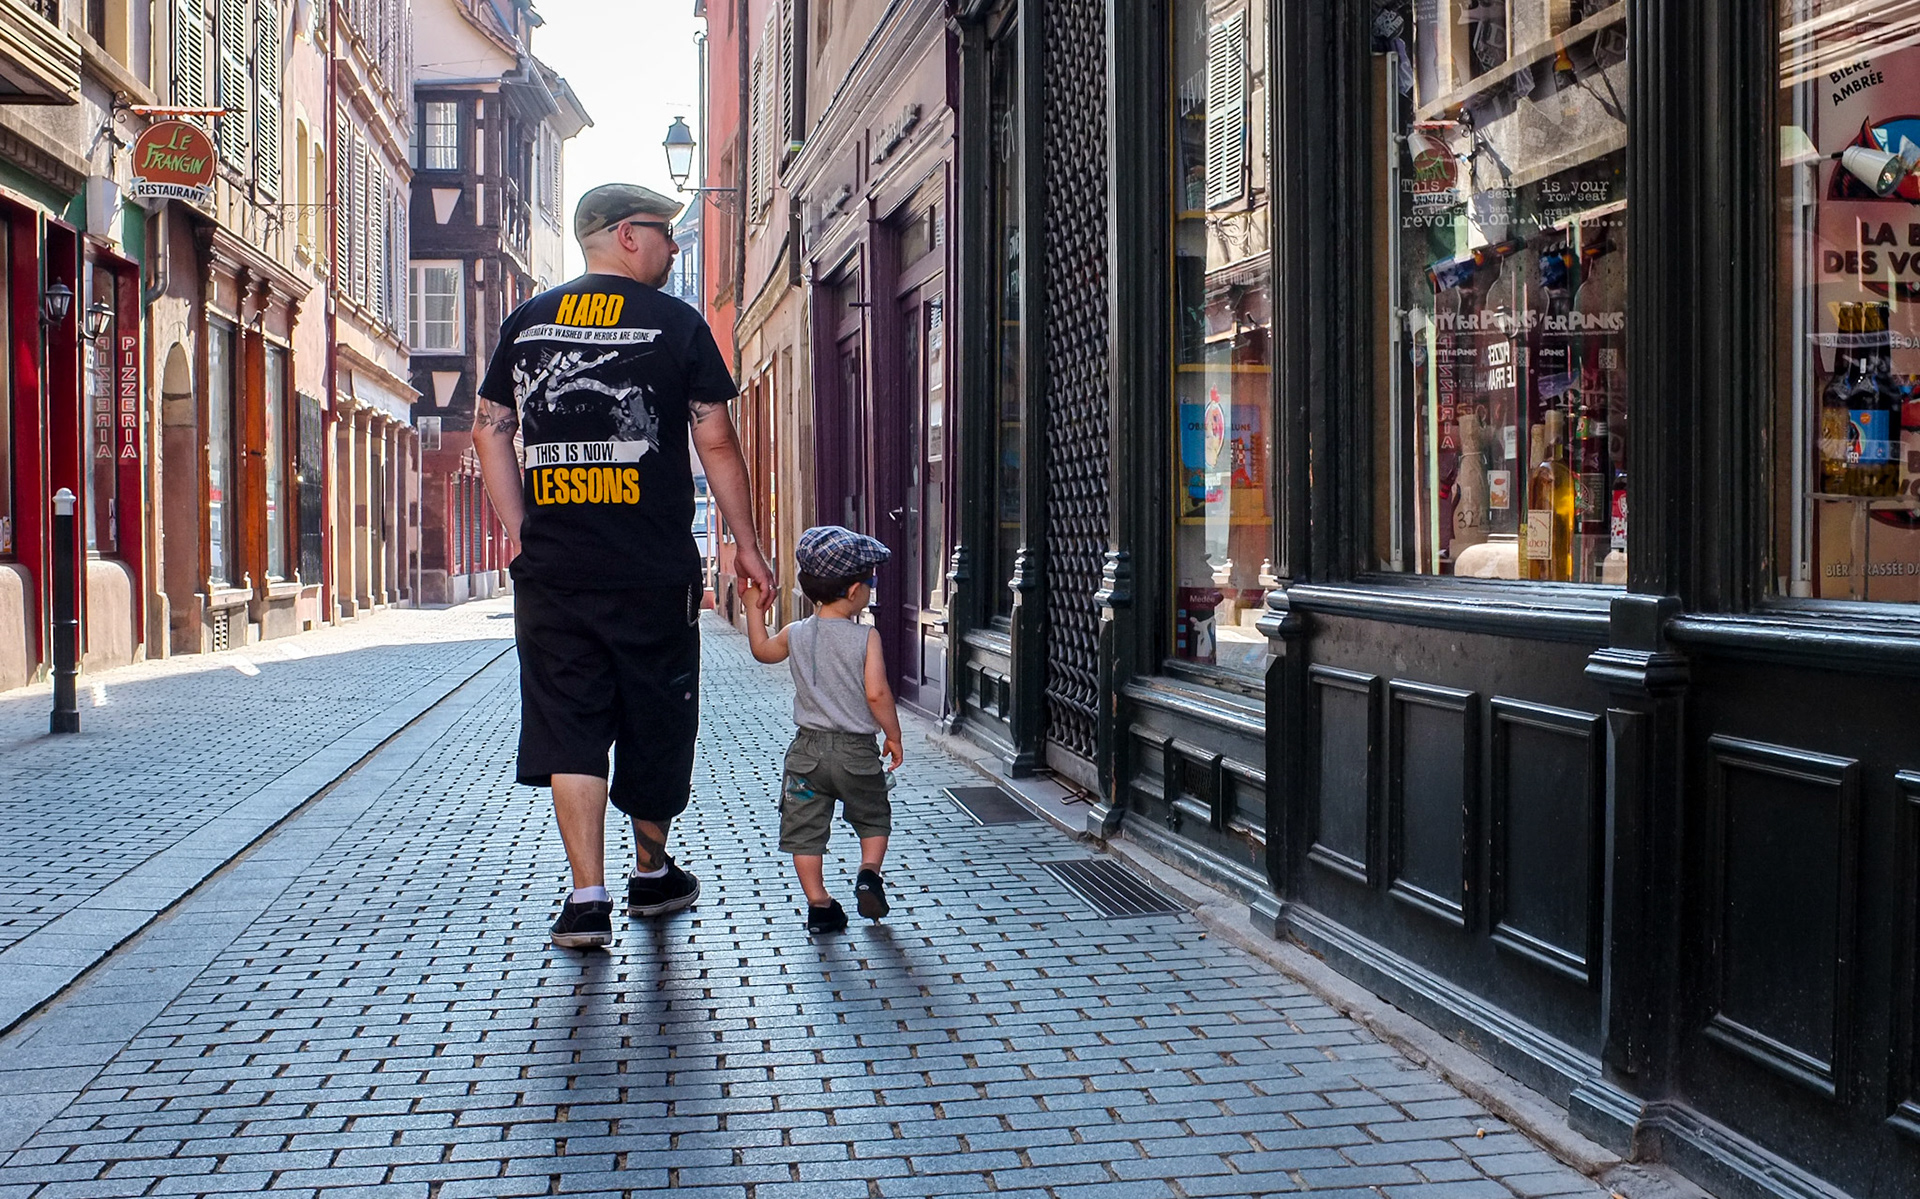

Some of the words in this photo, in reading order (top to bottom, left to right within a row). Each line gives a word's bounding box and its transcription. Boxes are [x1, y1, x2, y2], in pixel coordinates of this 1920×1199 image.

[1832, 70, 1884, 106] AMBRÉE
[167, 125, 194, 151] LE
[141, 142, 211, 175] FRANGIN
[137, 184, 206, 202] RESTAURANT
[1571, 180, 1609, 195] your
[1578, 190, 1607, 201] seat
[1861, 222, 1898, 246] LA
[1823, 250, 1878, 275] DES
[554, 293, 625, 327] HARD
[1568, 311, 1625, 331] PUNKS
[554, 328, 582, 339] WASHED
[593, 330, 618, 341] HEROES
[619, 331, 631, 341] ARE
[121, 336, 137, 458] PIZZERIA
[535, 444, 560, 464] THIS
[565, 443, 578, 463] IS
[583, 443, 618, 462] NOW.
[533, 467, 640, 506] LESSONS
